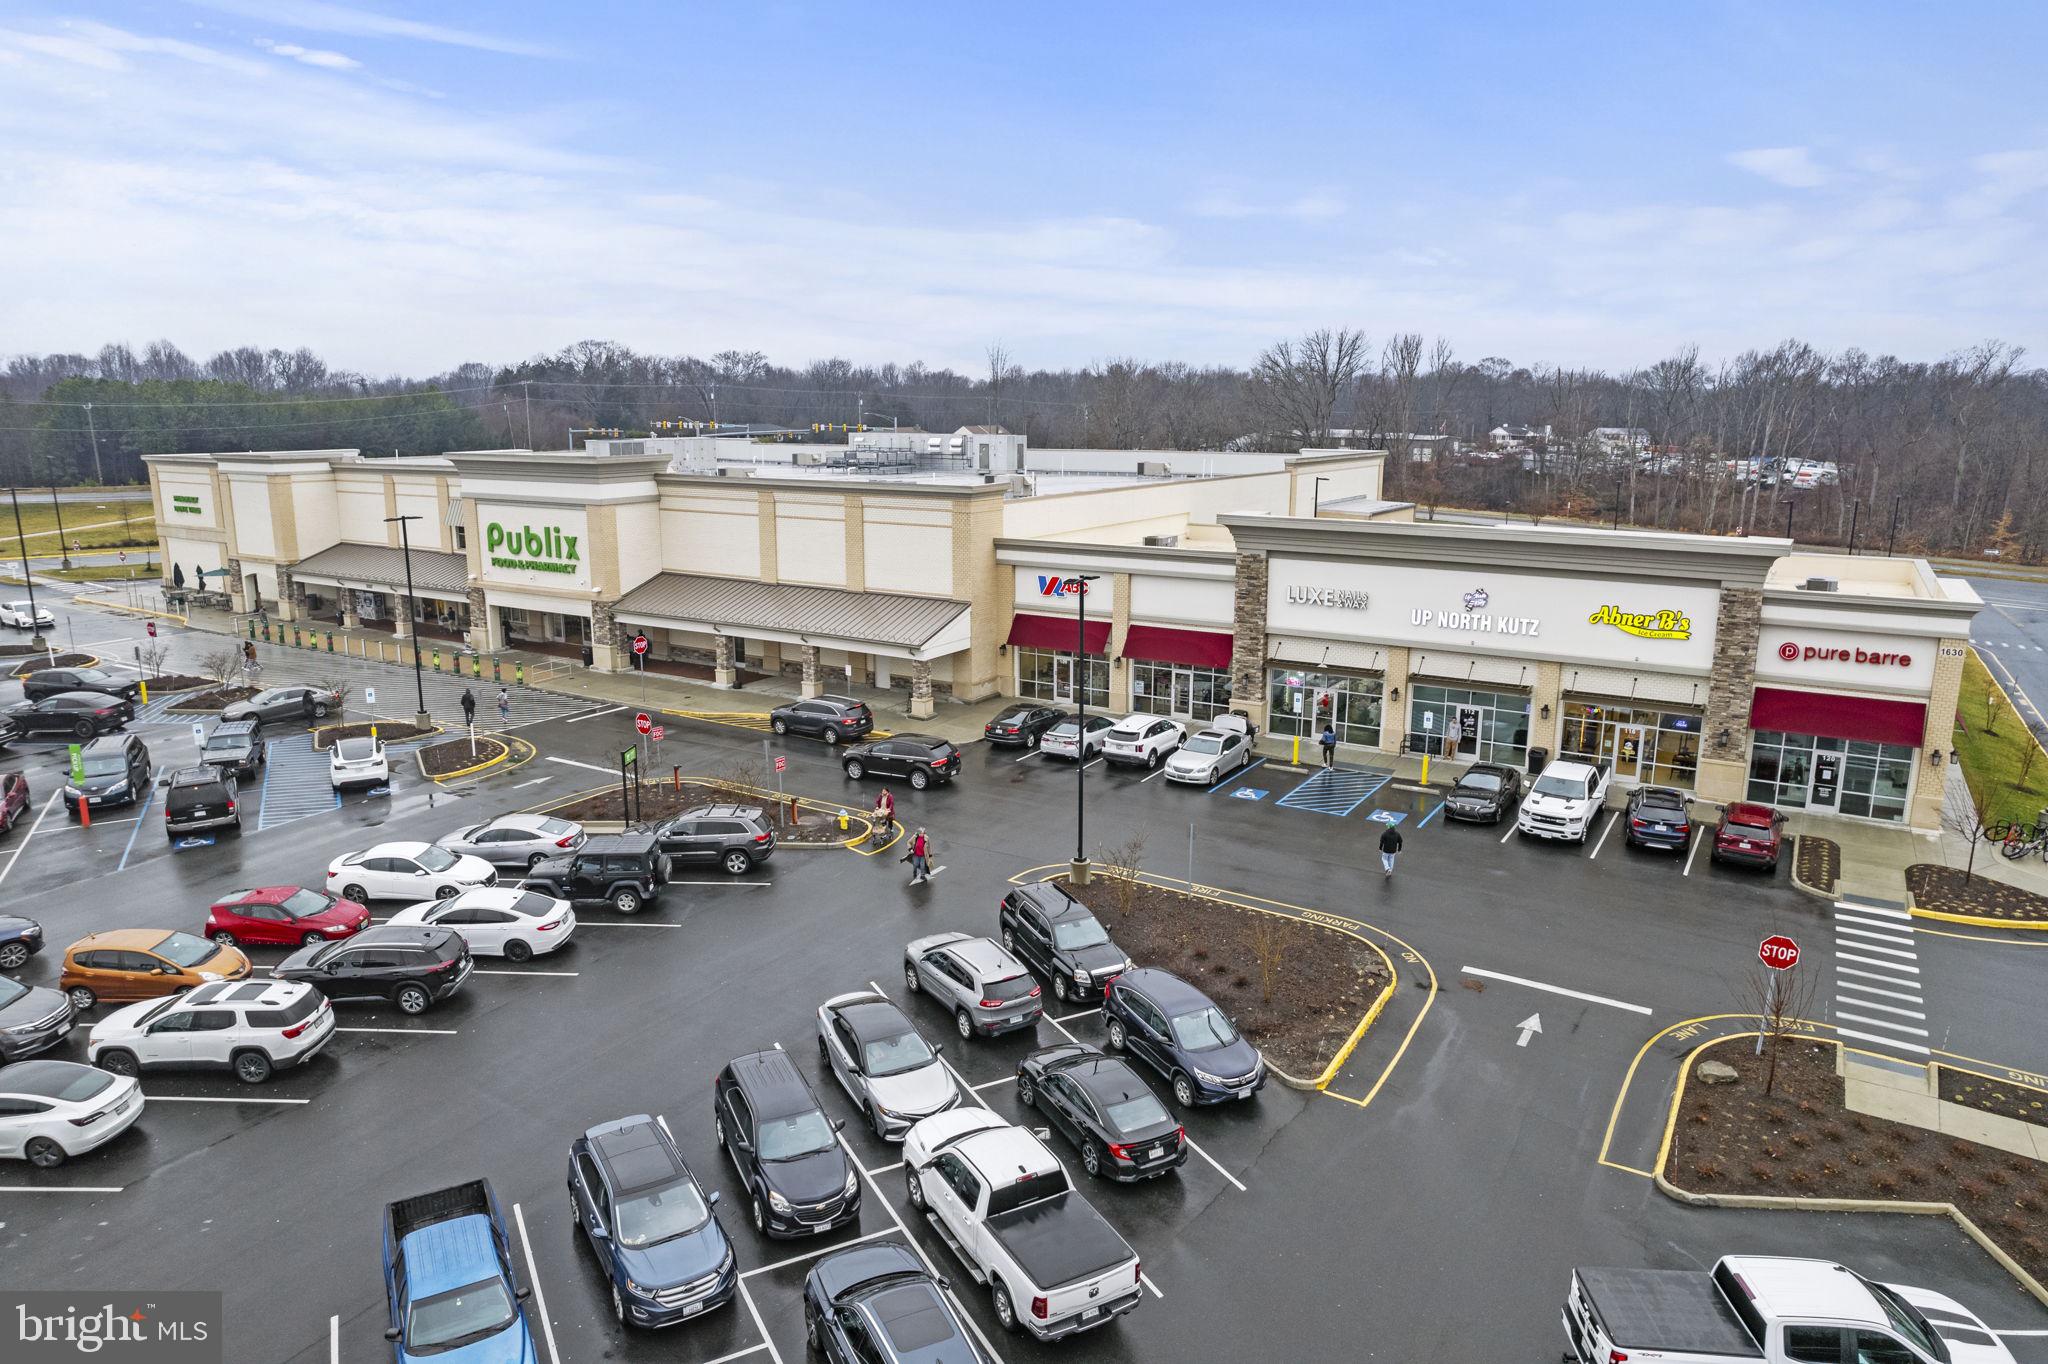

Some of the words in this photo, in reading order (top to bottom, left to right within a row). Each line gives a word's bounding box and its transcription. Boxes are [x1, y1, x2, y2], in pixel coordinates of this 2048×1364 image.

[487, 522, 580, 561] Publix
[491, 557, 517, 569] FOOD
[1286, 585, 1335, 607] LUXE
[1337, 590, 1368, 600] NAILS
[1411, 608, 1433, 626] UP
[1437, 611, 1492, 632] NORTH
[1497, 616, 1540, 637] KUTZ
[1589, 605, 1655, 629] Abner
[1656, 609, 1690, 631] B's
[1638, 629, 1648, 637] Ice
[1649, 630, 1673, 638] Cream
[634, 640, 647, 650] STOP
[1804, 646, 1850, 661] pure
[1855, 647, 1912, 667] barre
[1941, 648, 1963, 657] 1630
[637, 719, 651, 729] STOP
[1190, 885, 1220, 897] FIRE
[1301, 911, 1360, 931] PARKING
[1401, 952, 1421, 964] NO
[1762, 944, 1797, 961] STOP
[1668, 1022, 1709, 1041] LANE
